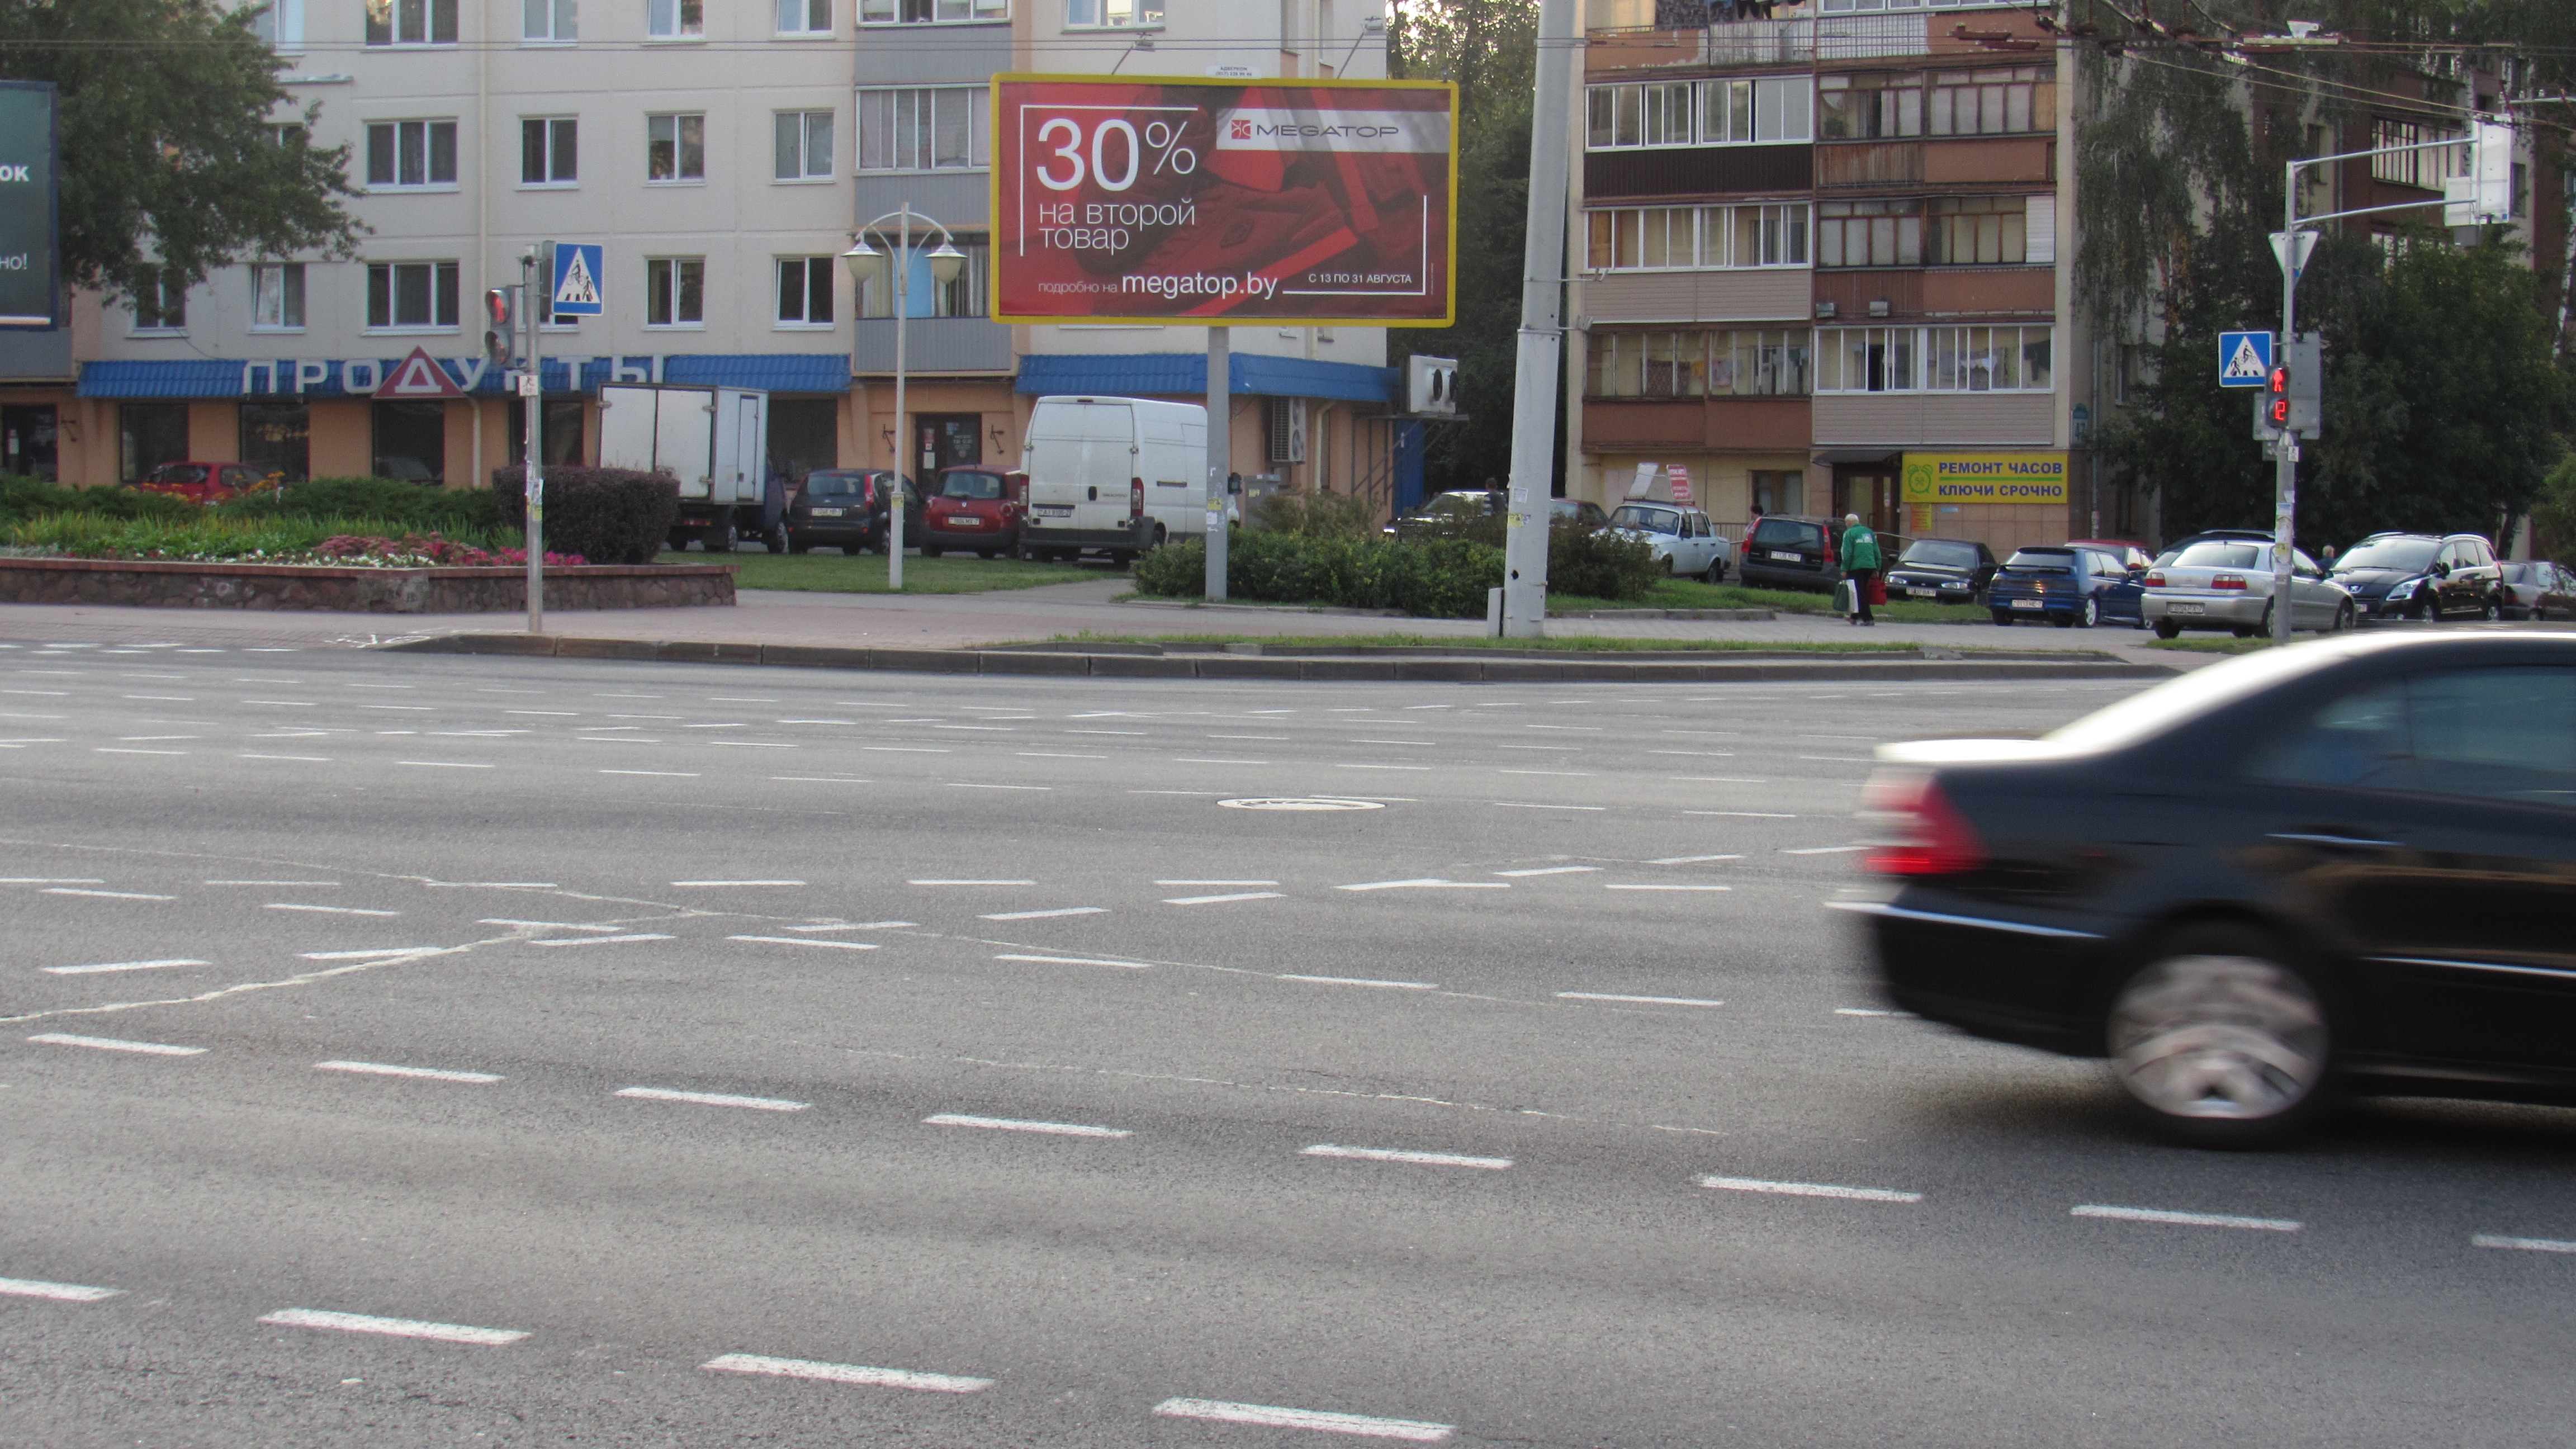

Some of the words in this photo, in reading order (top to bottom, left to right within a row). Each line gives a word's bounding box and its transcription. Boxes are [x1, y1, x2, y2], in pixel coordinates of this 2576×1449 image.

[1257, 124, 1399, 137] MEGATOP
[1036, 117, 1196, 191] 30%
[1039, 203, 1076, 224] на
[1086, 197, 1195, 231] второй
[1038, 228, 1130, 255] товар
[1038, 281, 1100, 295] подробно
[1103, 283, 1117, 293] на
[1121, 272, 1278, 300] megatop.by
[1308, 273, 1317, 283] С
[1320, 273, 1332, 283] 13
[1334, 273, 1350, 283] ПО
[1352, 274, 1363, 283] 31
[1366, 274, 1413, 284] АВГУСТА
[1939, 462, 2003, 473] РЕМОНТ
[2009, 462, 2063, 474] ЧАСОВ
[1939, 485, 1994, 496] КЛЮЧИ
[1999, 485, 2063, 496] СРОЧНО
